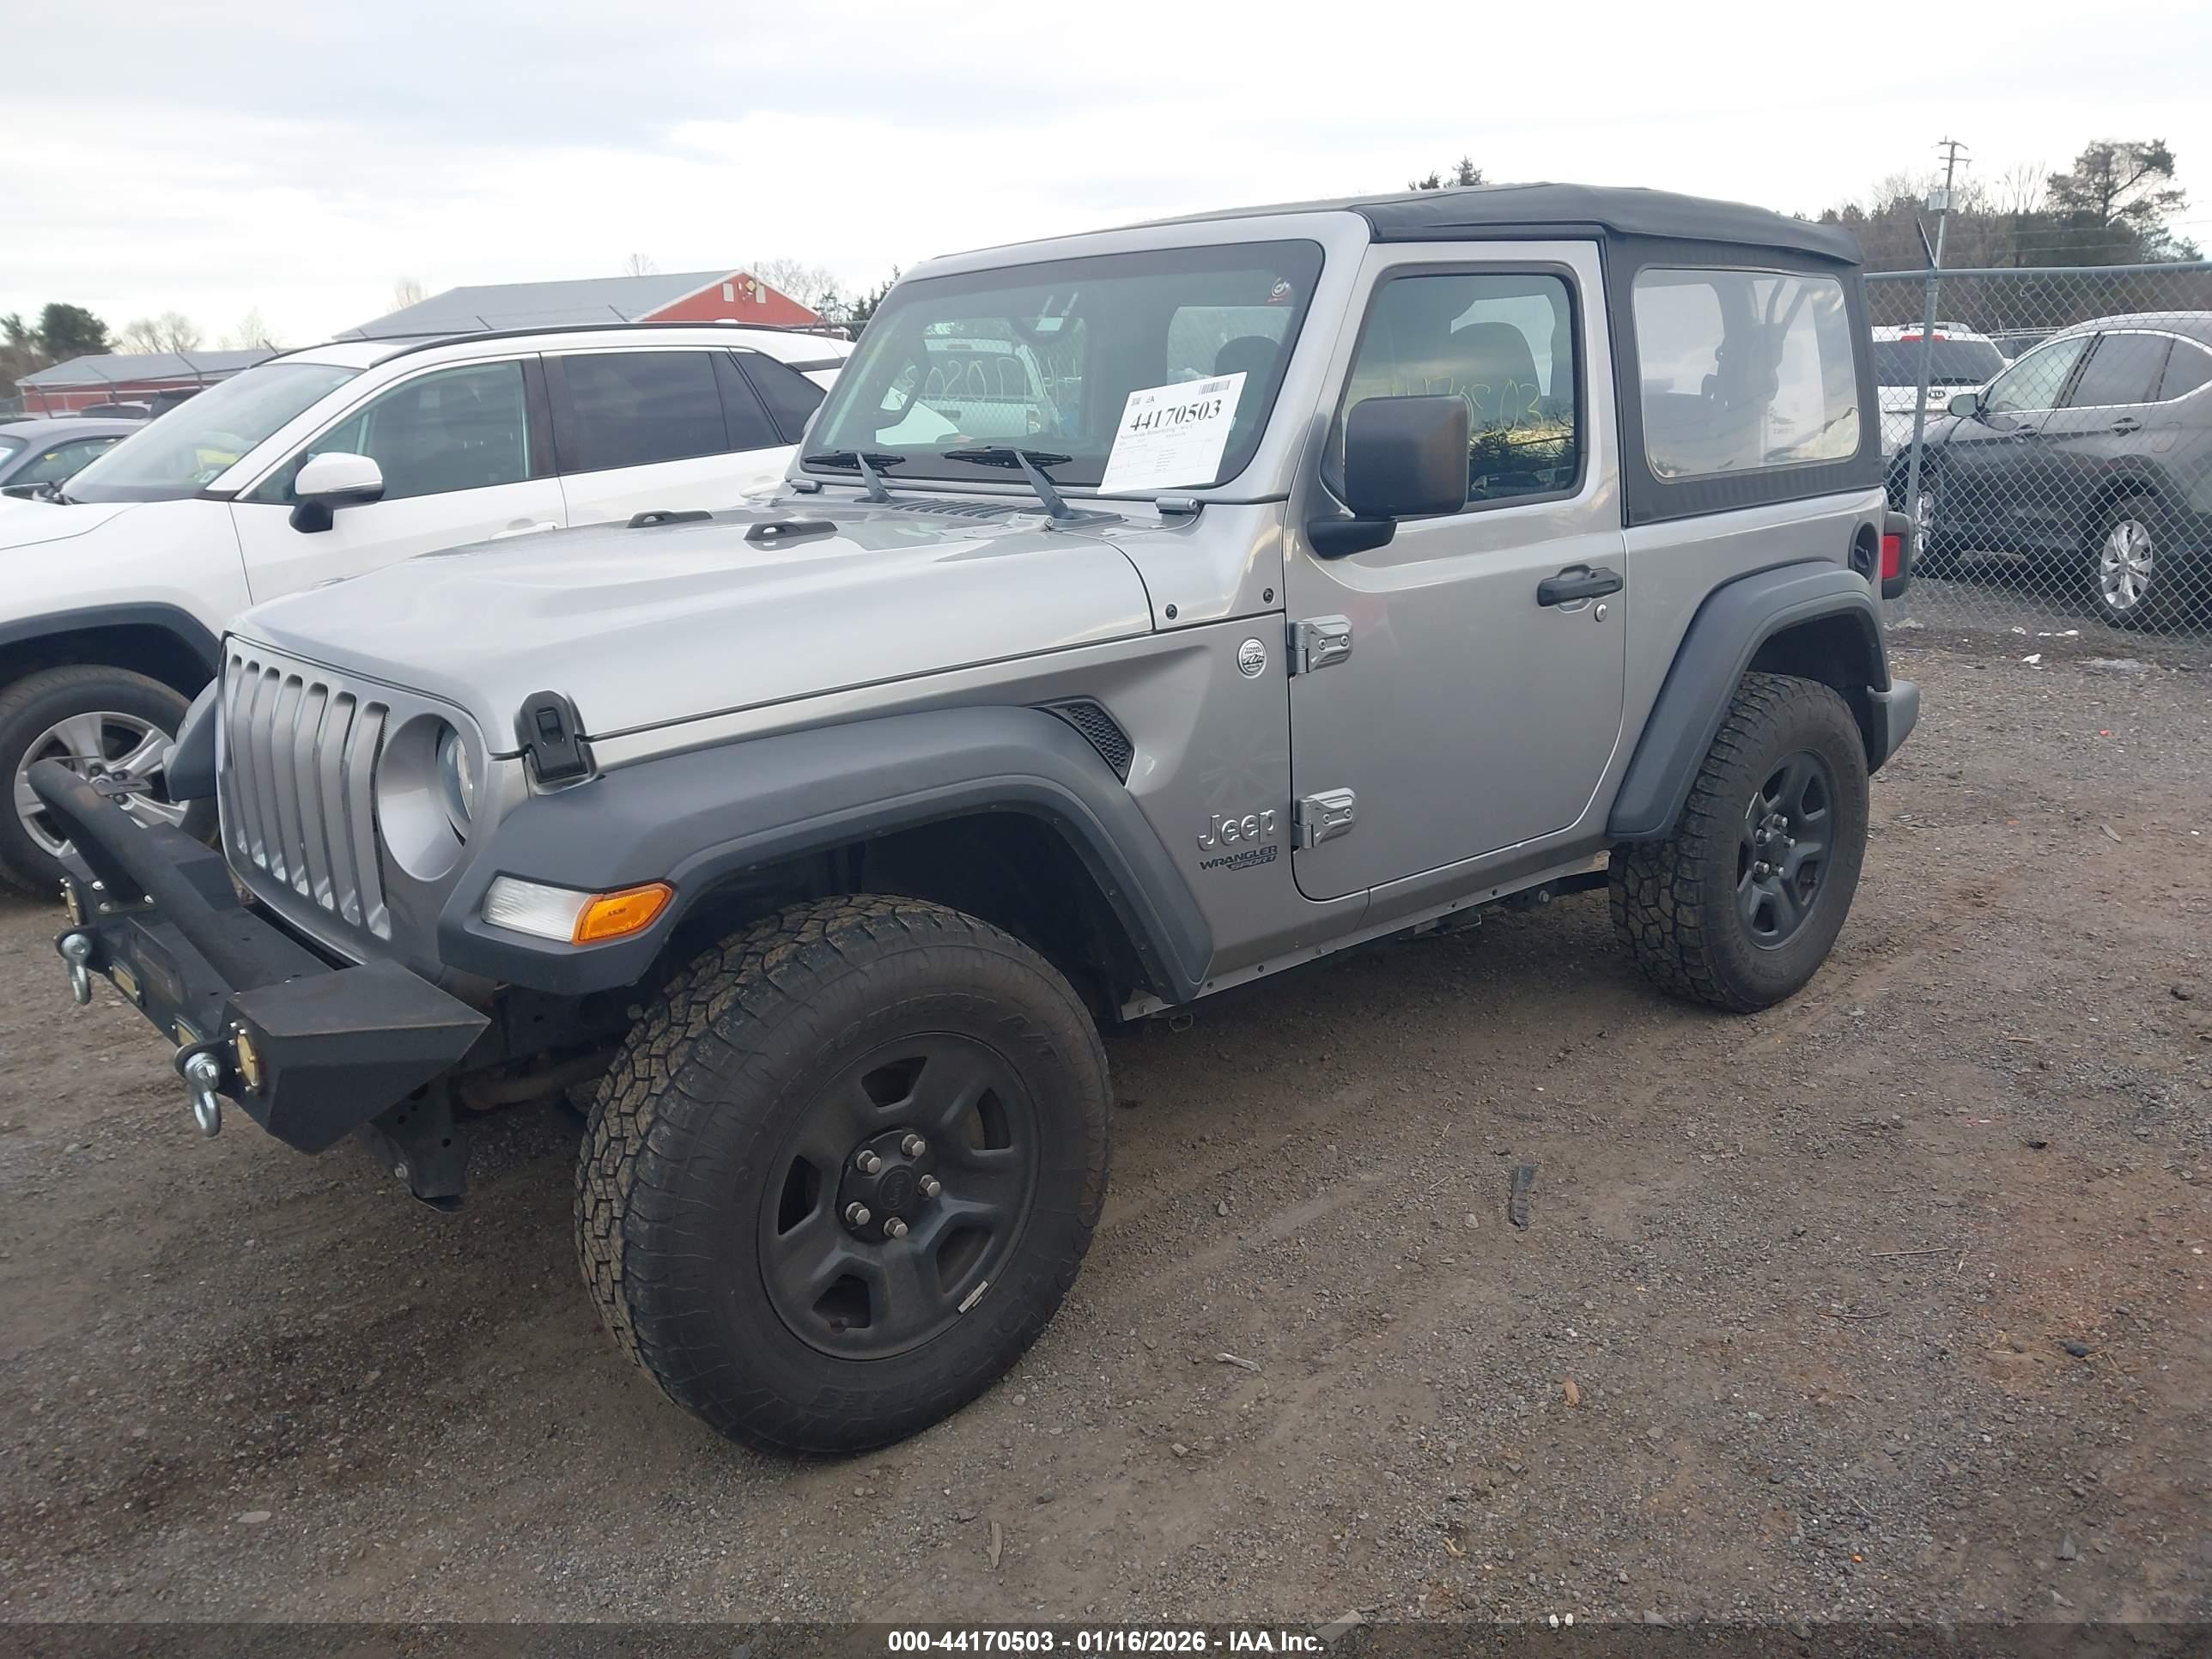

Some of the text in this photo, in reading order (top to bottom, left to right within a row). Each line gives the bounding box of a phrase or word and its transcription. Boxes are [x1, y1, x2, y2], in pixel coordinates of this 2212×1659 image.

[1130, 399, 1222, 431] 44170503
[1197, 809, 1276, 852] Jeep
[1200, 845, 1278, 870] WRANGLER
